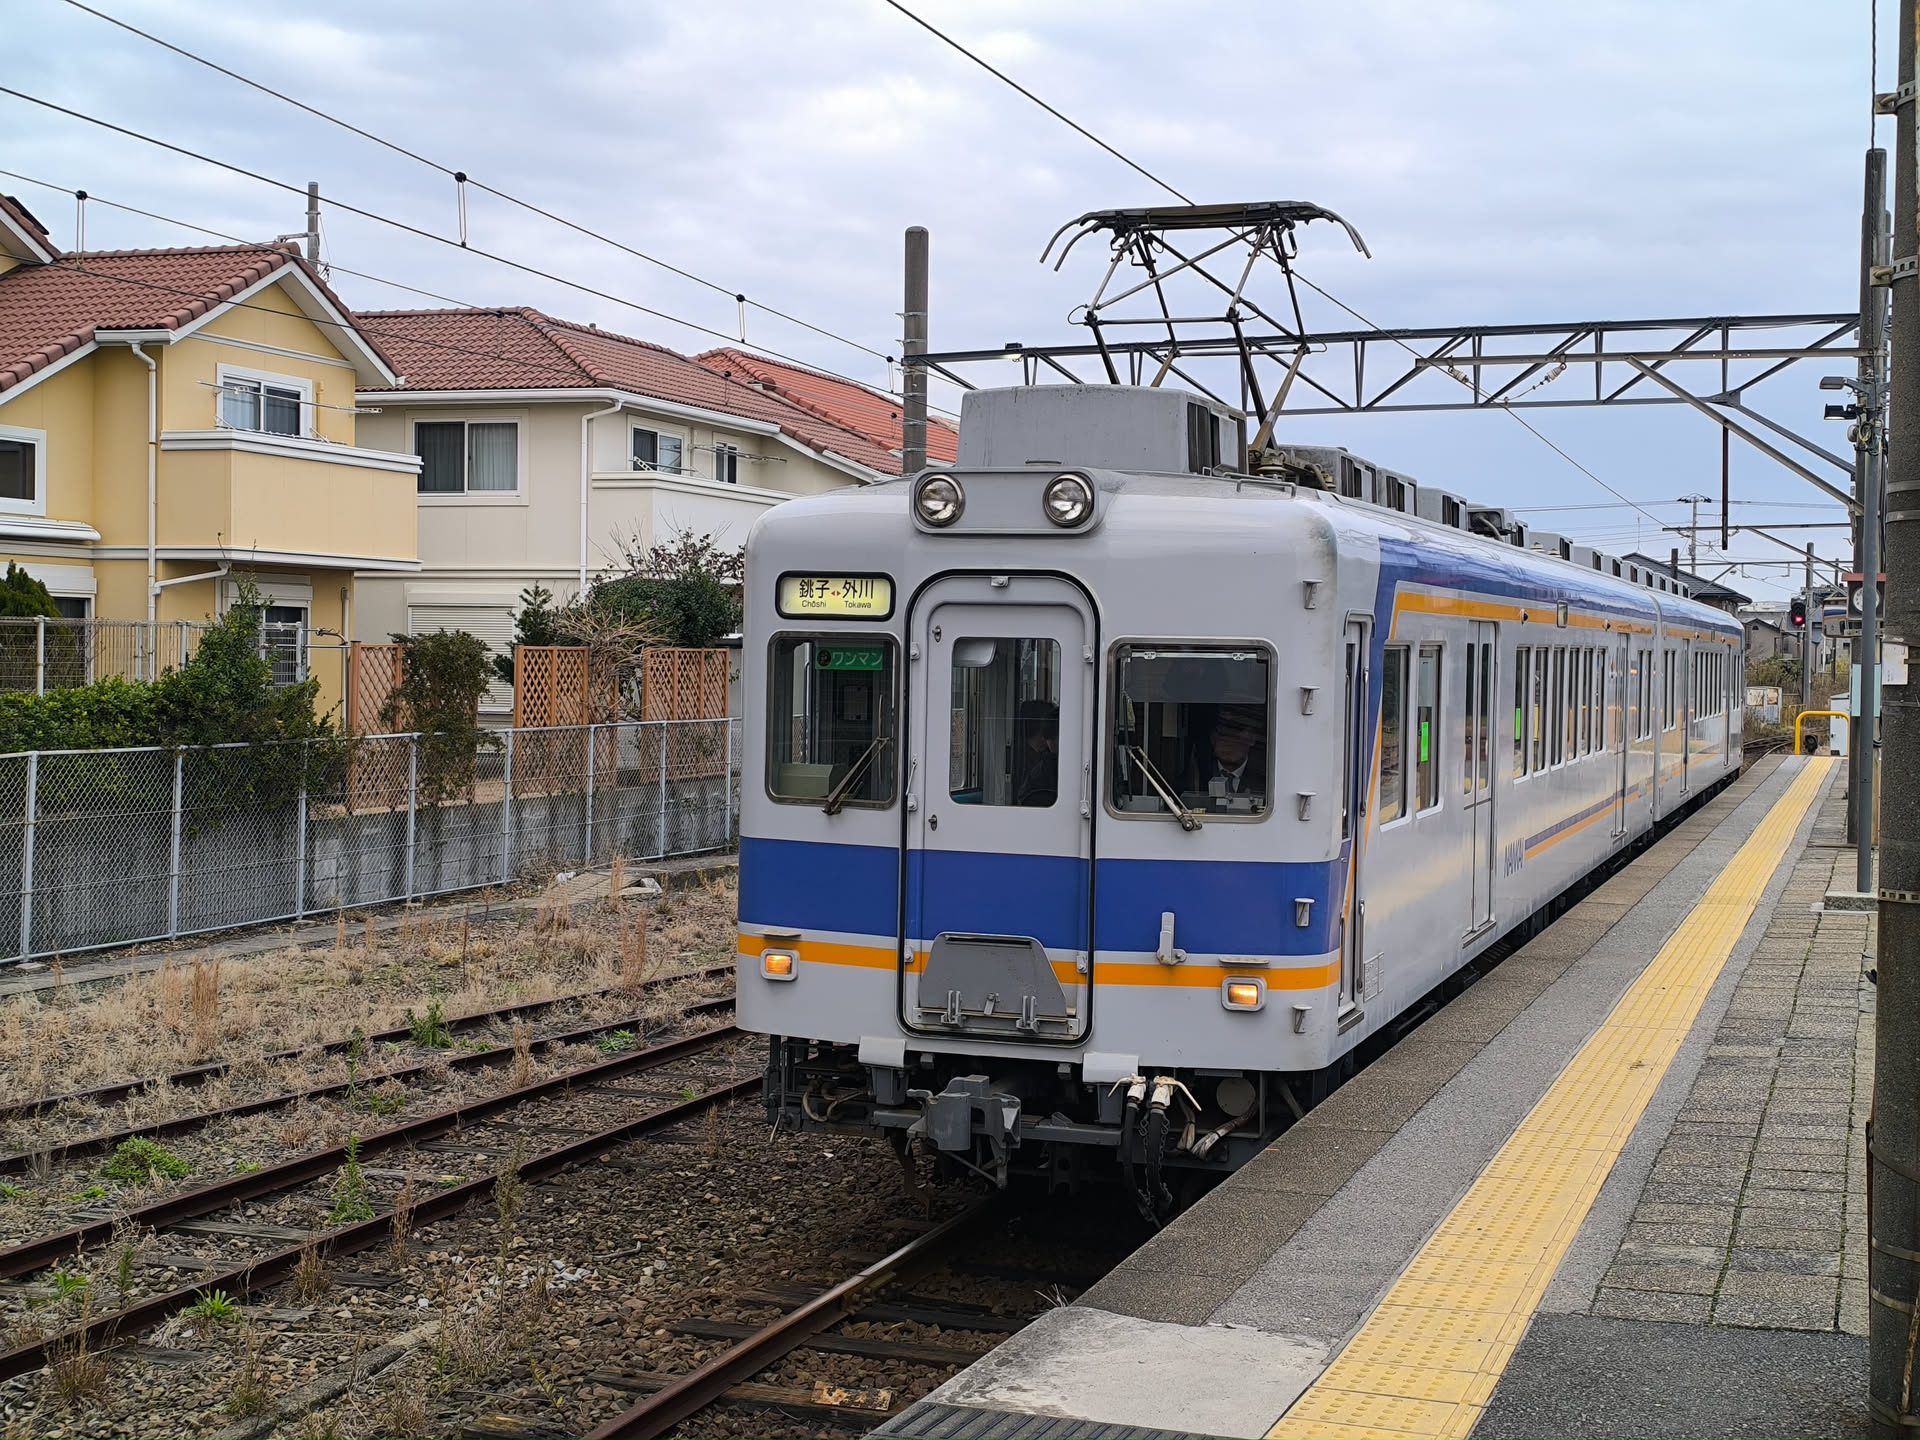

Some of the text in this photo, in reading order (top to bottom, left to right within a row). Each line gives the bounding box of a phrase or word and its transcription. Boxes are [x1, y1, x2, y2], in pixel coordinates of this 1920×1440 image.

[799, 579, 874, 599] 銚子 外川
[844, 600, 872, 609] Tokawa
[832, 652, 883, 666] ワンマン
